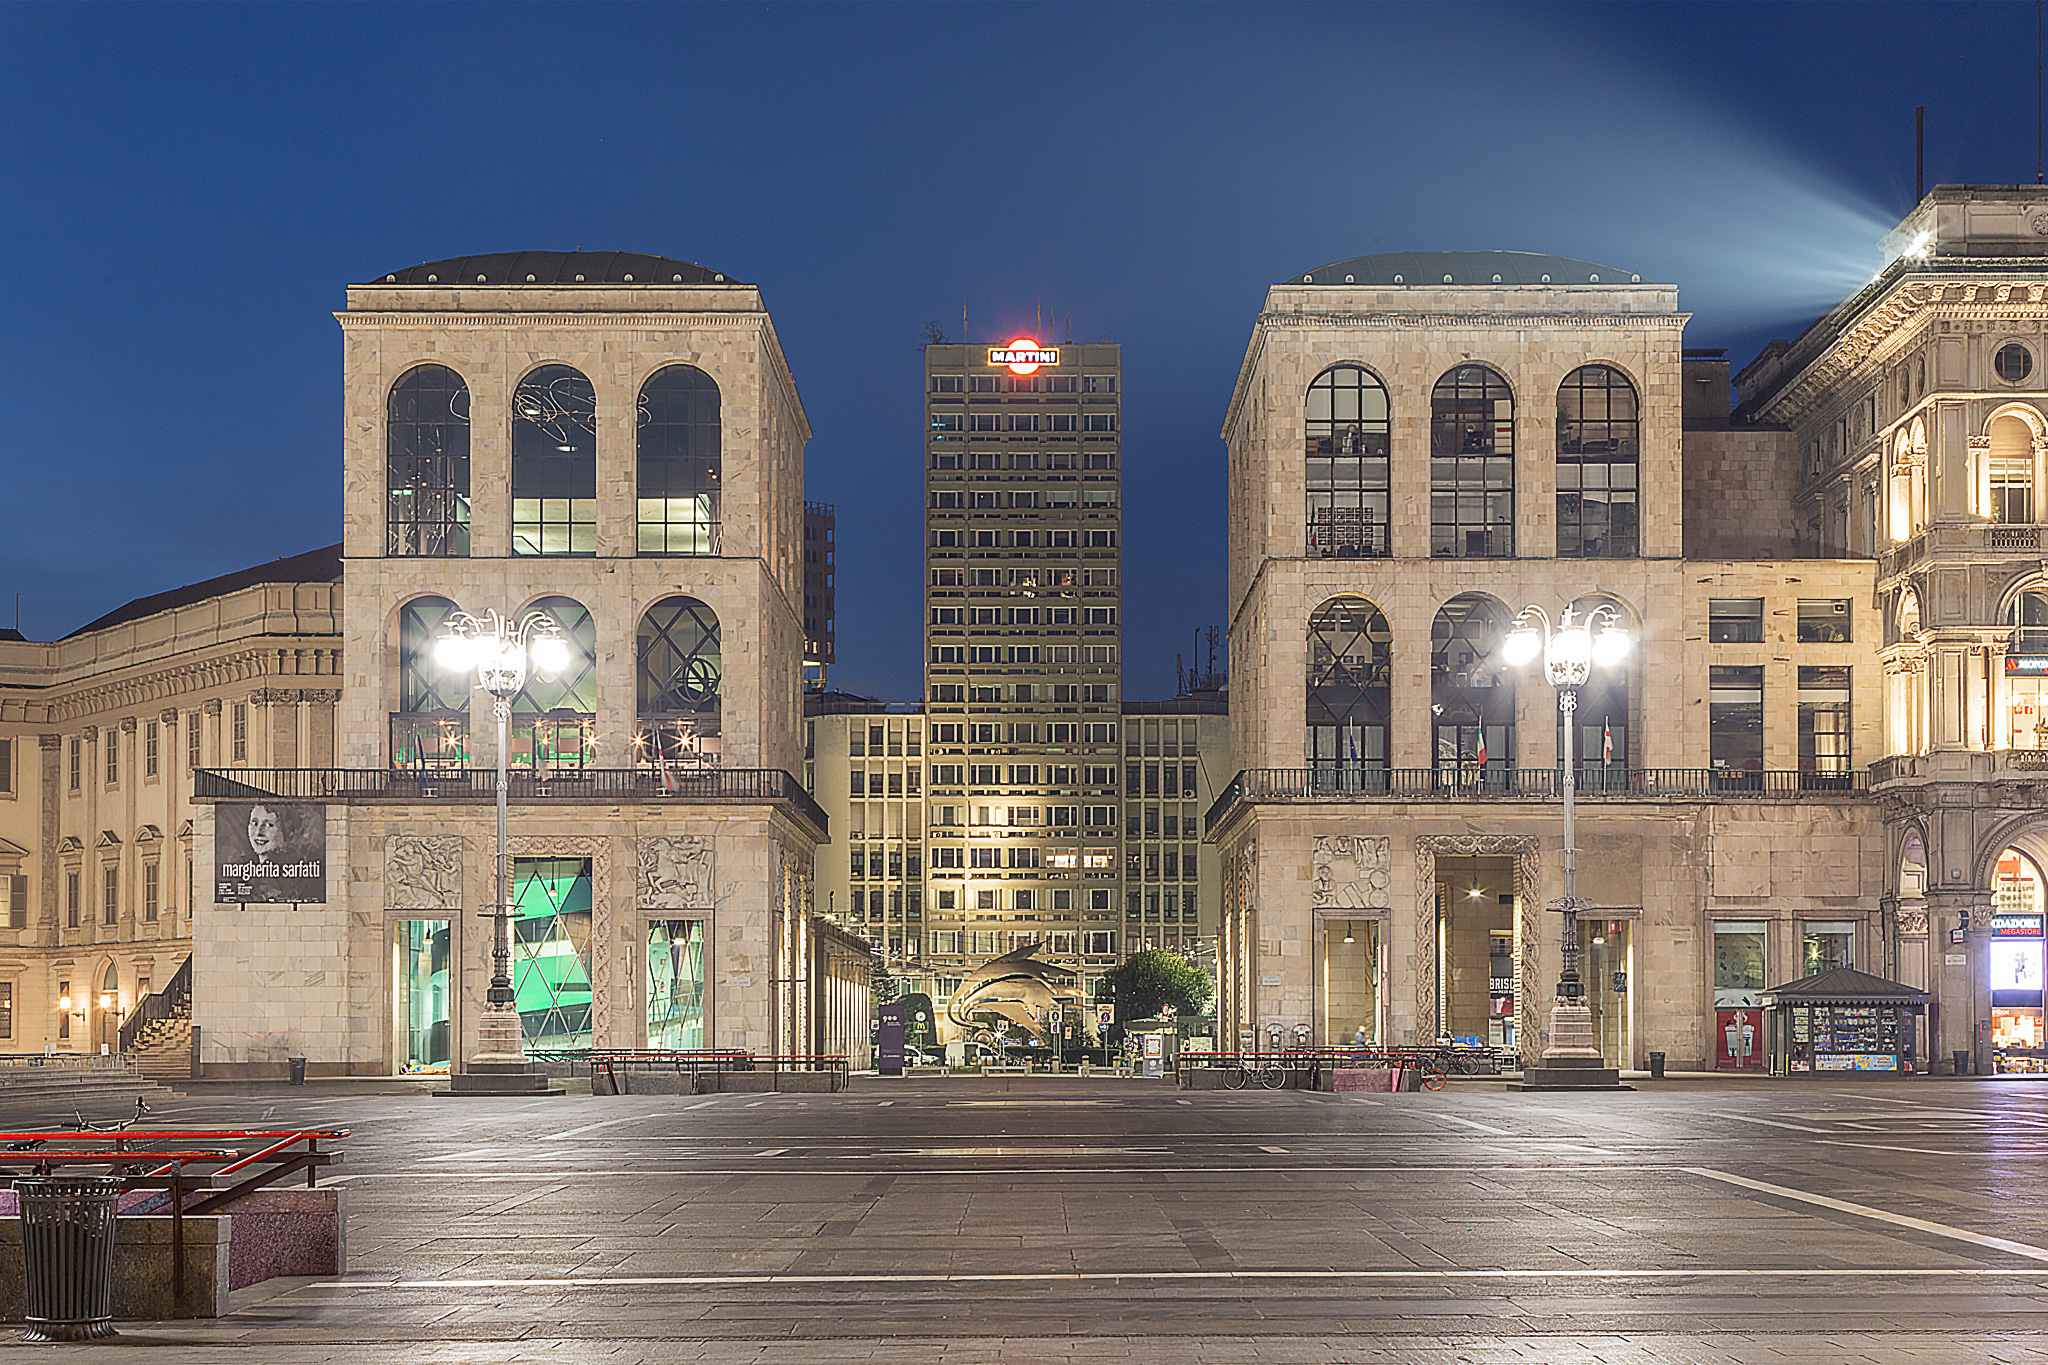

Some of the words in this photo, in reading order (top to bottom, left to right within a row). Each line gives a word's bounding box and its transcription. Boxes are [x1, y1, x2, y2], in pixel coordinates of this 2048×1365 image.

[992, 351, 1055, 362] MARTINI
[222, 860, 280, 881] margherita
[281, 860, 320, 878] sarfatti
